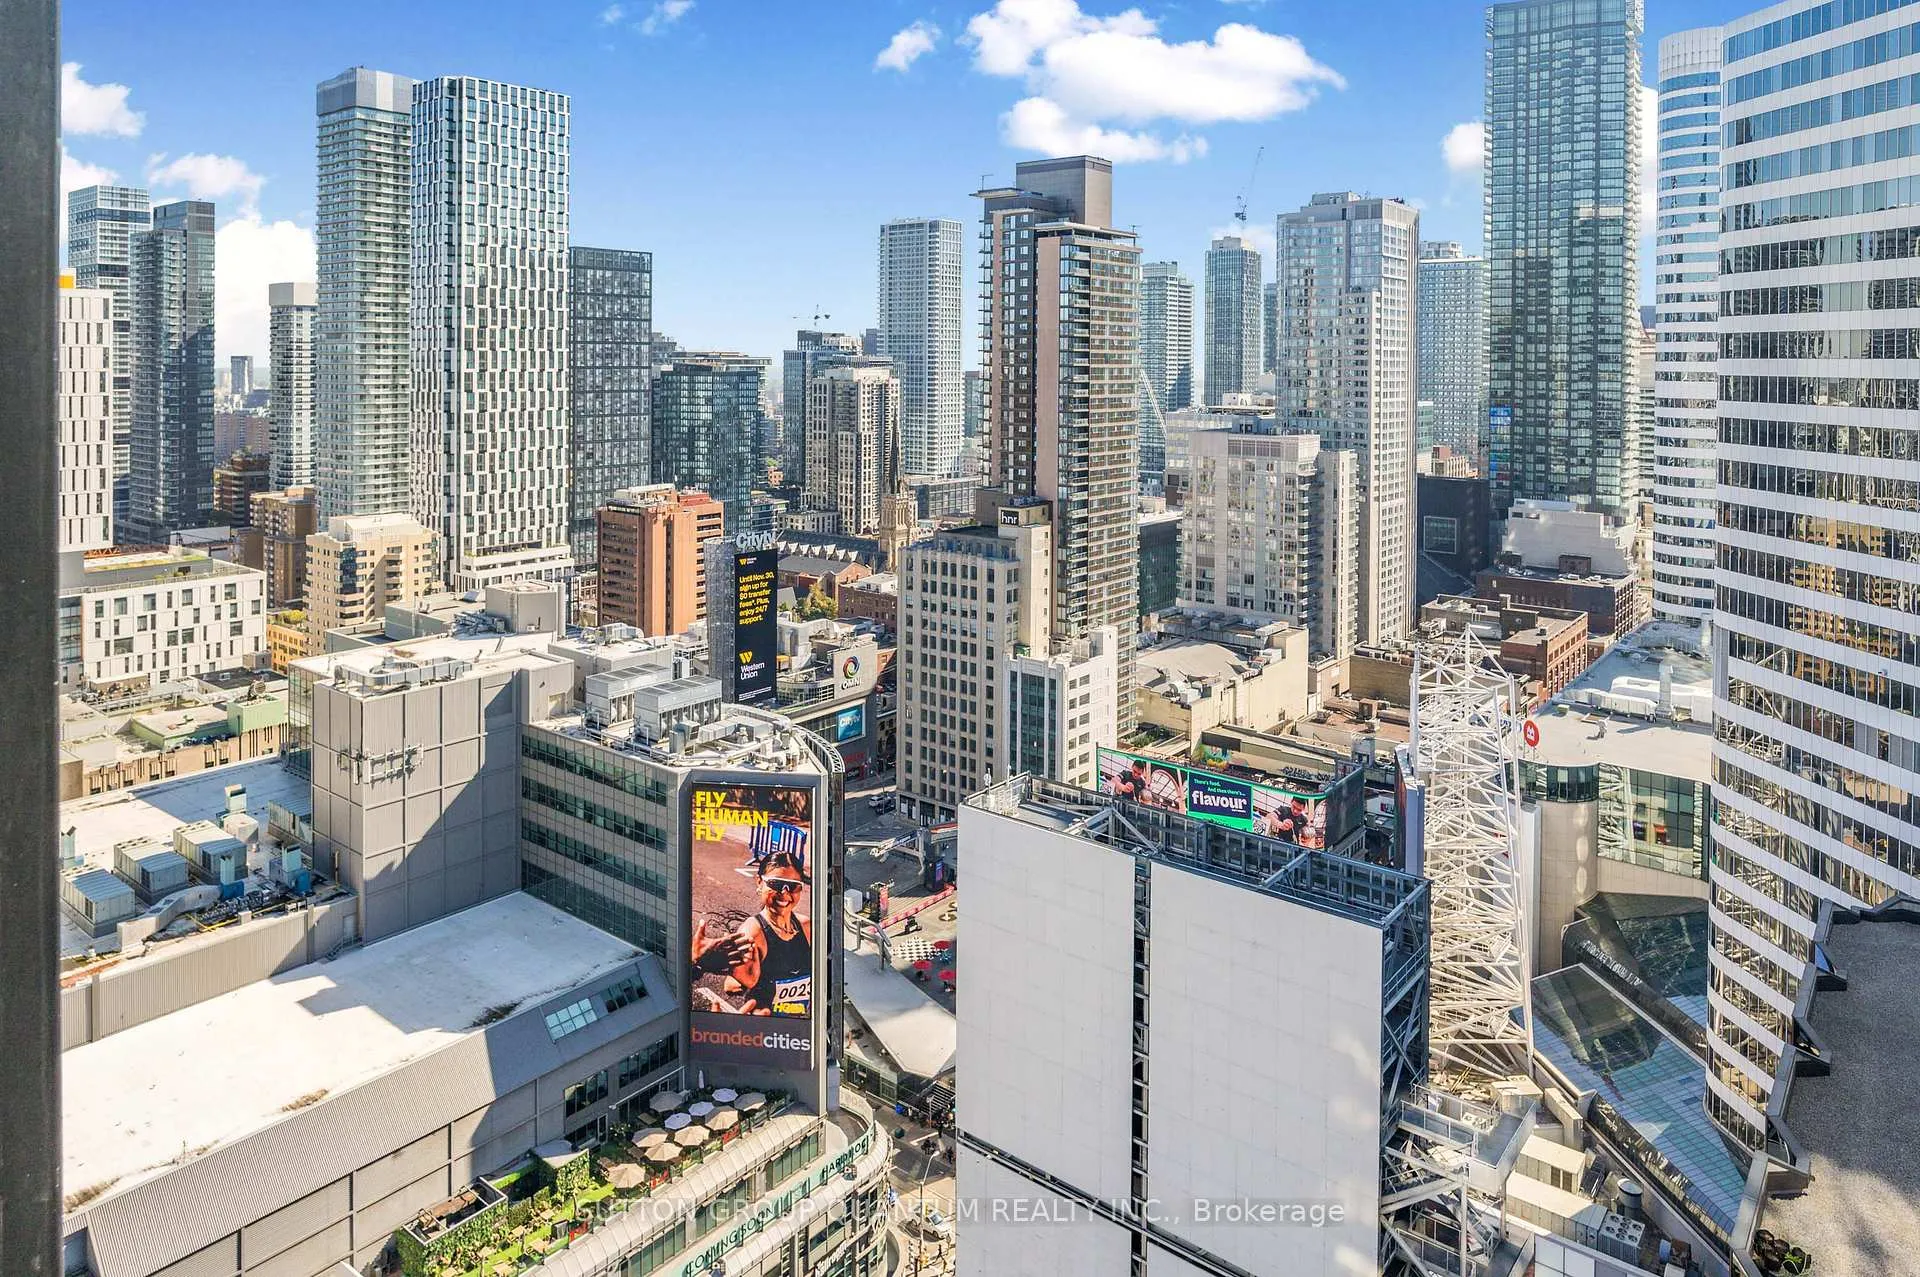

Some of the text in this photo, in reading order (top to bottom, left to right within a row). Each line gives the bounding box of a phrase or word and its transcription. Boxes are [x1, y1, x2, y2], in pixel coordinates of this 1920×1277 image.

[1001, 511, 1018, 524] hnr
[740, 575, 752, 583] Until
[765, 571, 774, 579] 30,
[740, 584, 751, 593] sign
[749, 589, 771, 598] transfer
[740, 604, 767, 617] enjoy 24/7
[740, 614, 763, 625] support.
[741, 662, 765, 673] Western
[741, 671, 758, 680] Union
[841, 677, 862, 690] OMNI
[695, 790, 726, 808] FLY
[1192, 790, 1247, 810] flavour
[695, 808, 768, 827] HUMAN
[695, 825, 725, 842] FLY
[691, 1026, 811, 1050] brandedcities
